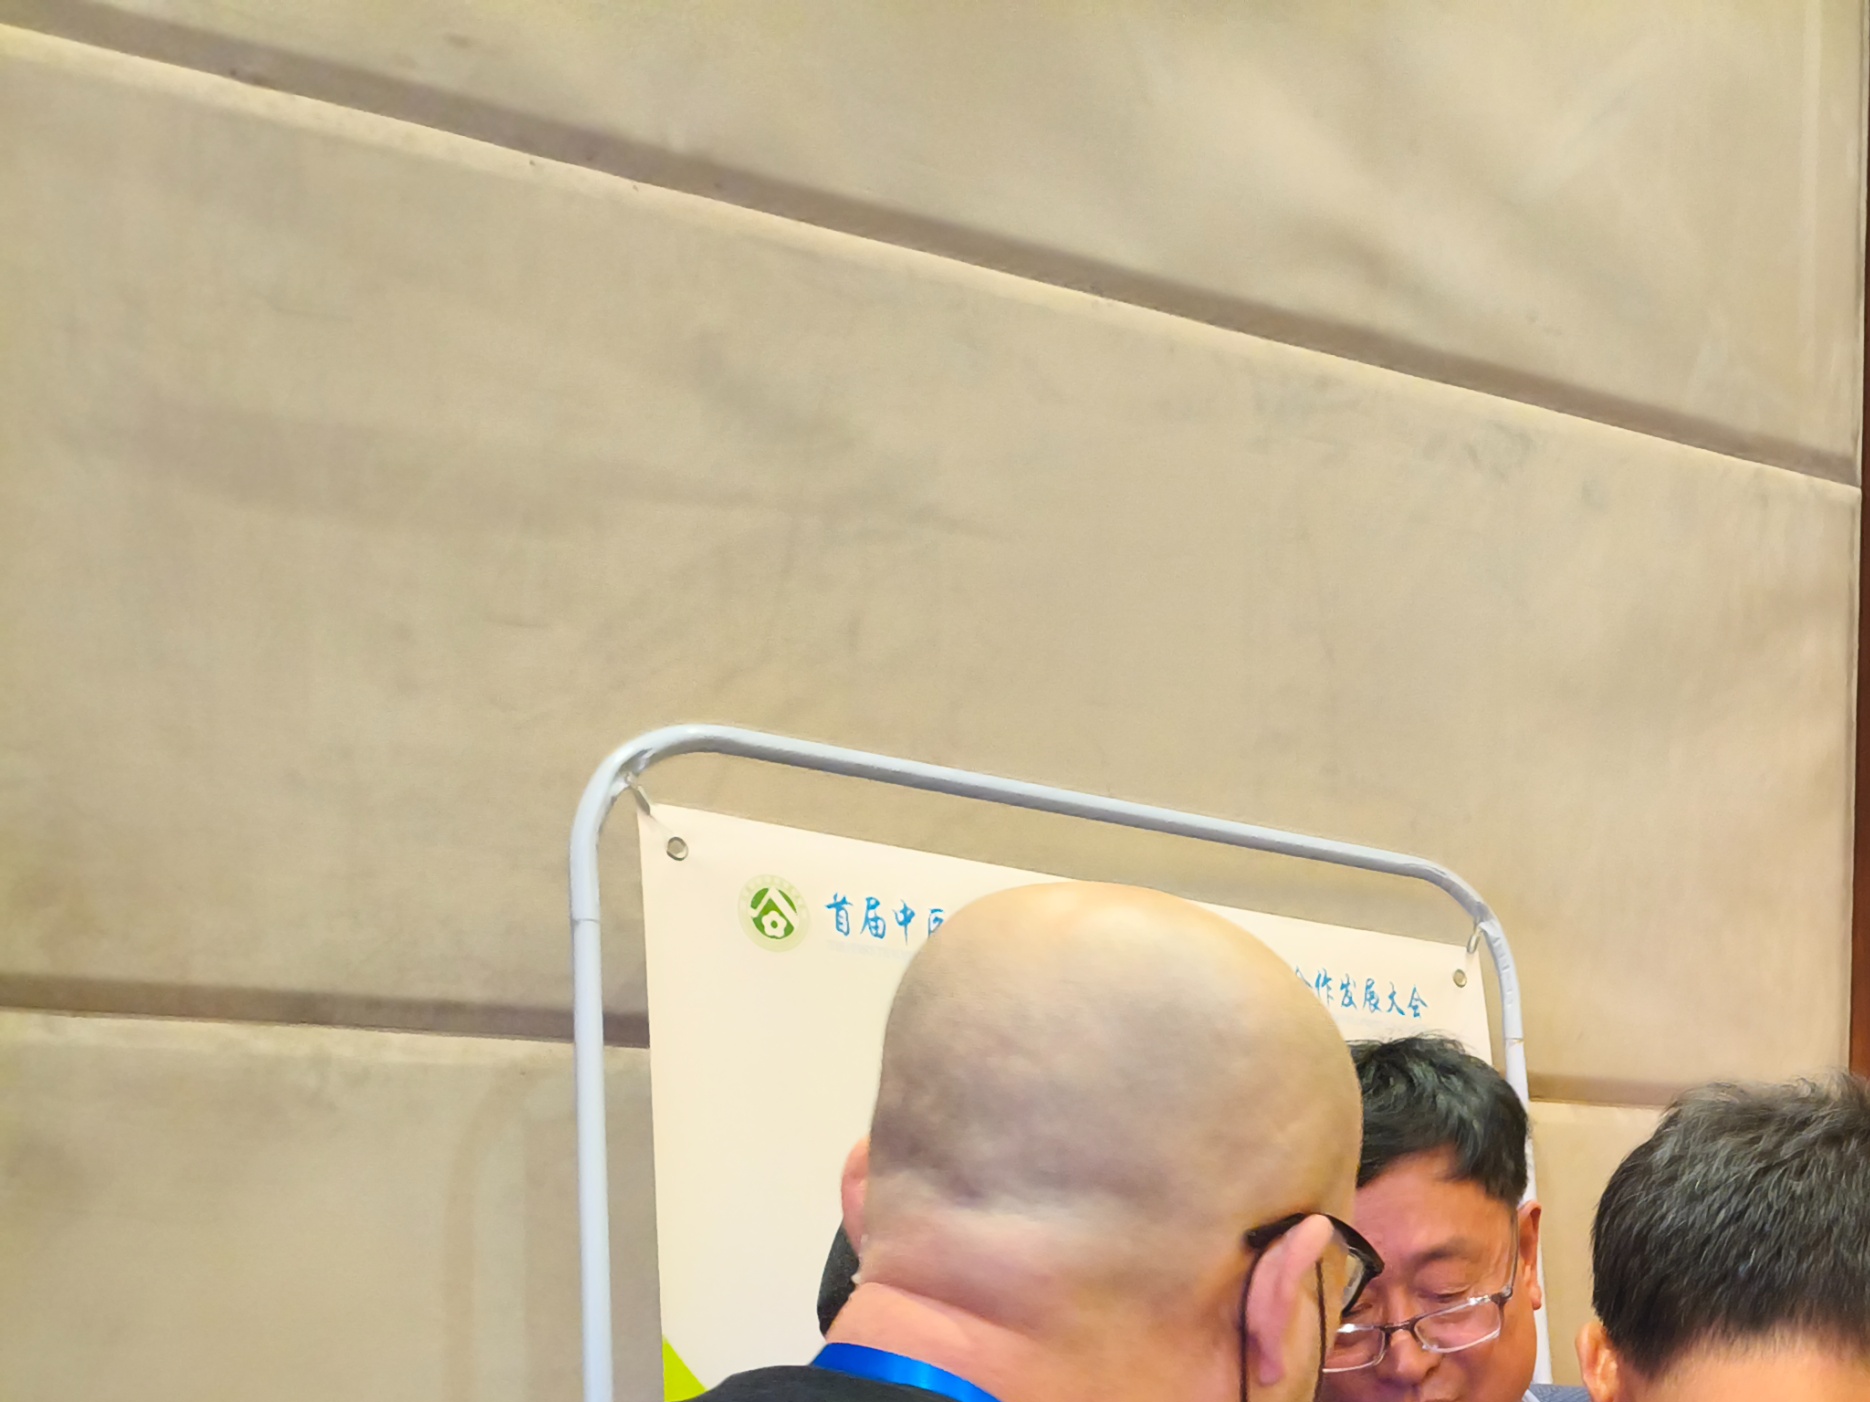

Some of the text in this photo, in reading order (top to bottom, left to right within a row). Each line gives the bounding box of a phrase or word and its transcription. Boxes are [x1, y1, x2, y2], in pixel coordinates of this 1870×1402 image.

[1295, 965, 1429, 1018] 作发展大会
